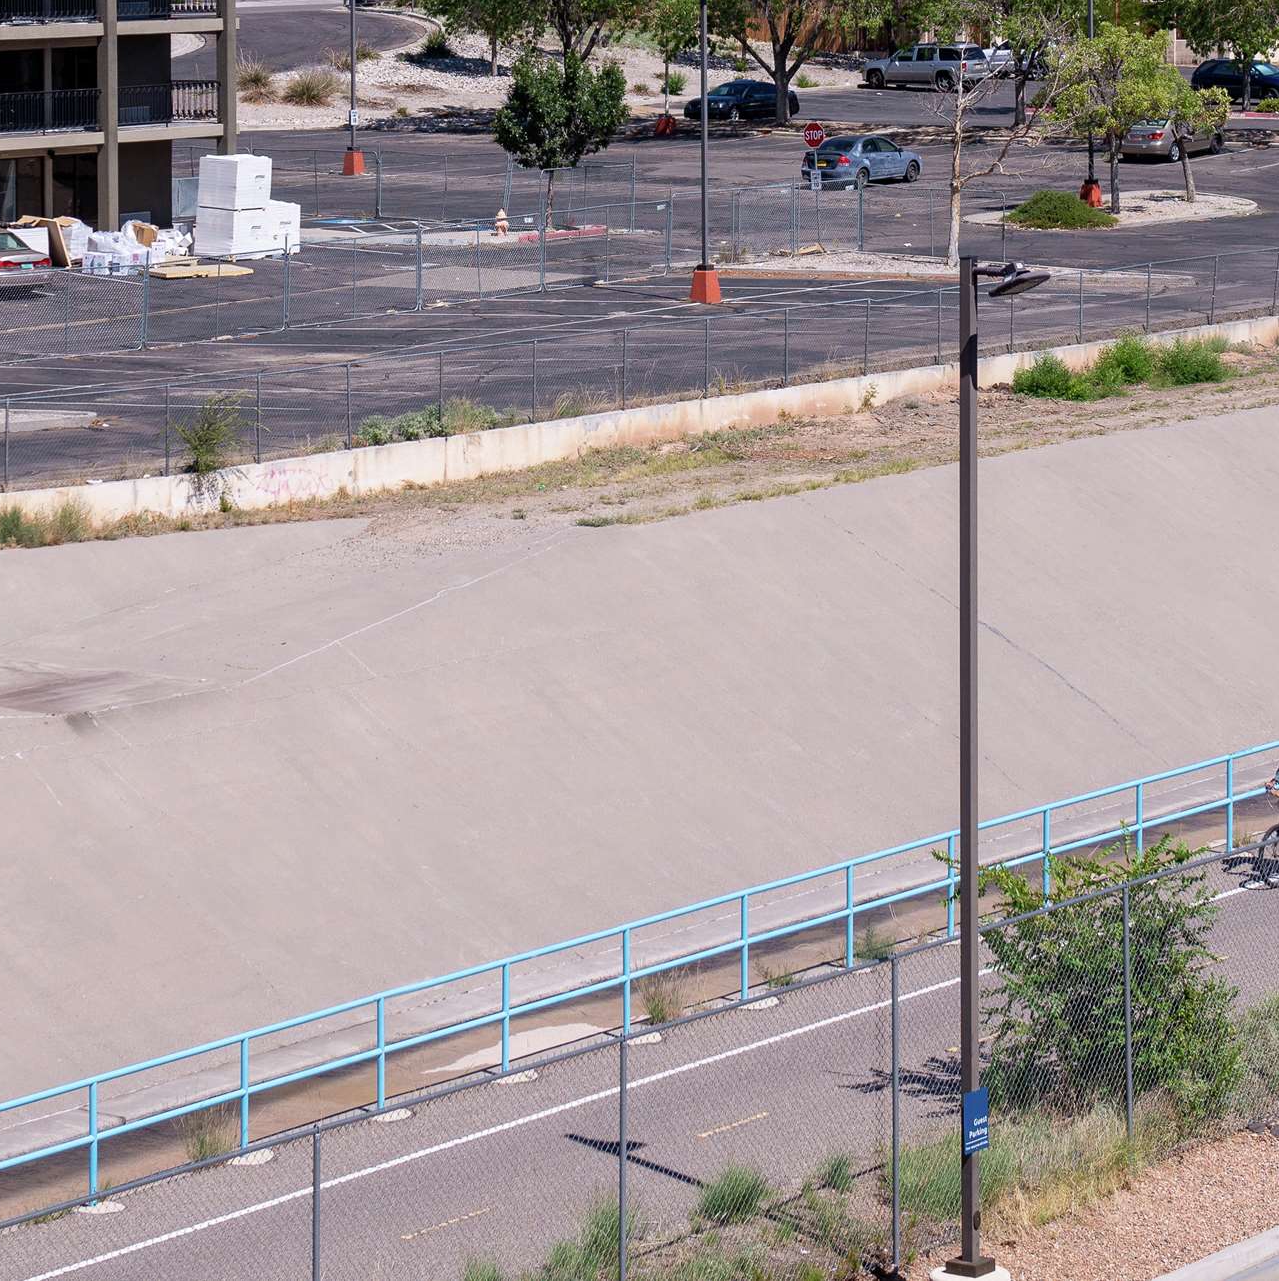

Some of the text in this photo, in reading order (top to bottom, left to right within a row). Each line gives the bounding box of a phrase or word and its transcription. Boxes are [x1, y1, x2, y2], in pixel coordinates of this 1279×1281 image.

[805, 130, 823, 140] STOP
[974, 1115, 987, 1126] Guest
[969, 1127, 987, 1138] Parking
